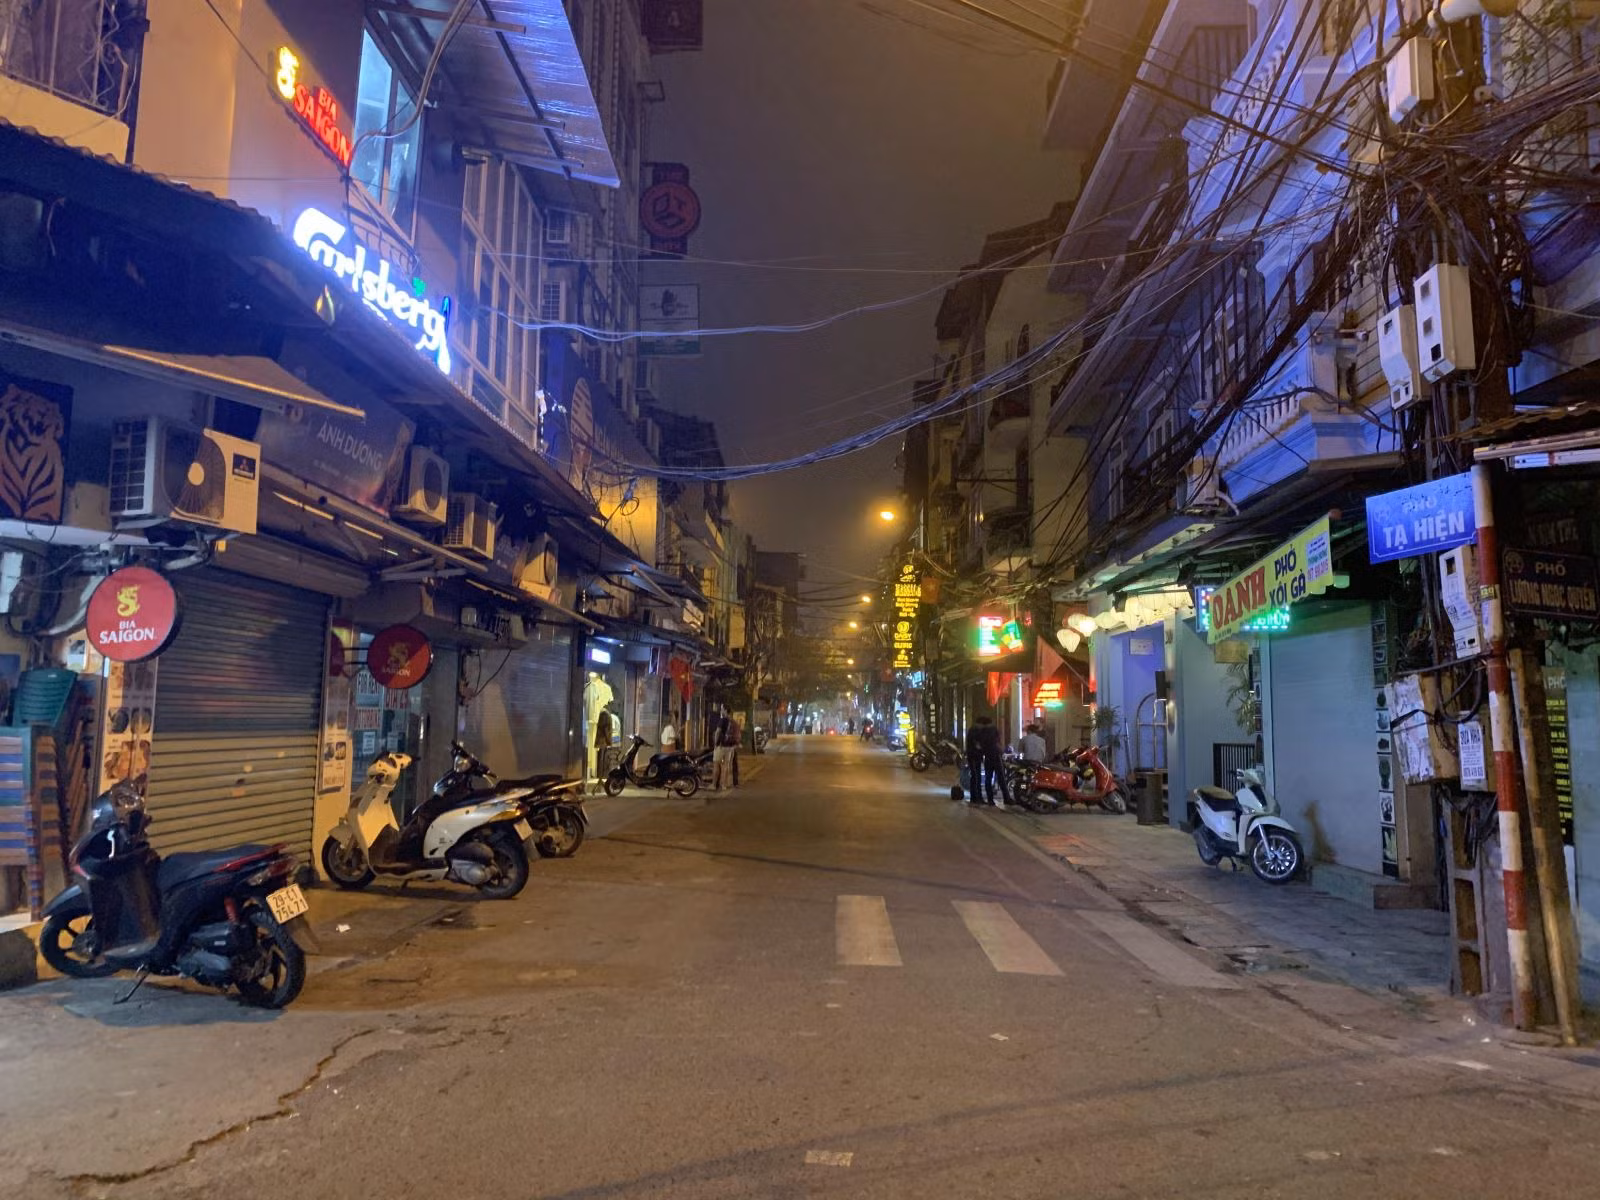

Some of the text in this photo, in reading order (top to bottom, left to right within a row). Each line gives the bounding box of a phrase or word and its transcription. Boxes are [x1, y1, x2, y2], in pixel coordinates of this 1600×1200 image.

[319, 87, 337, 121] BIA
[293, 208, 451, 376] Carlsberg
[1383, 509, 1465, 550] TẠ HIỆN
[1535, 558, 1566, 576] PHỐ
[1213, 566, 1267, 631] OANH
[1270, 580, 1288, 609] XÔI
[1290, 568, 1306, 599] GÀ
[99, 627, 155, 644] SAIGON
[119, 620, 137, 630] BIA
[272, 888, 298, 909] 29-C1
